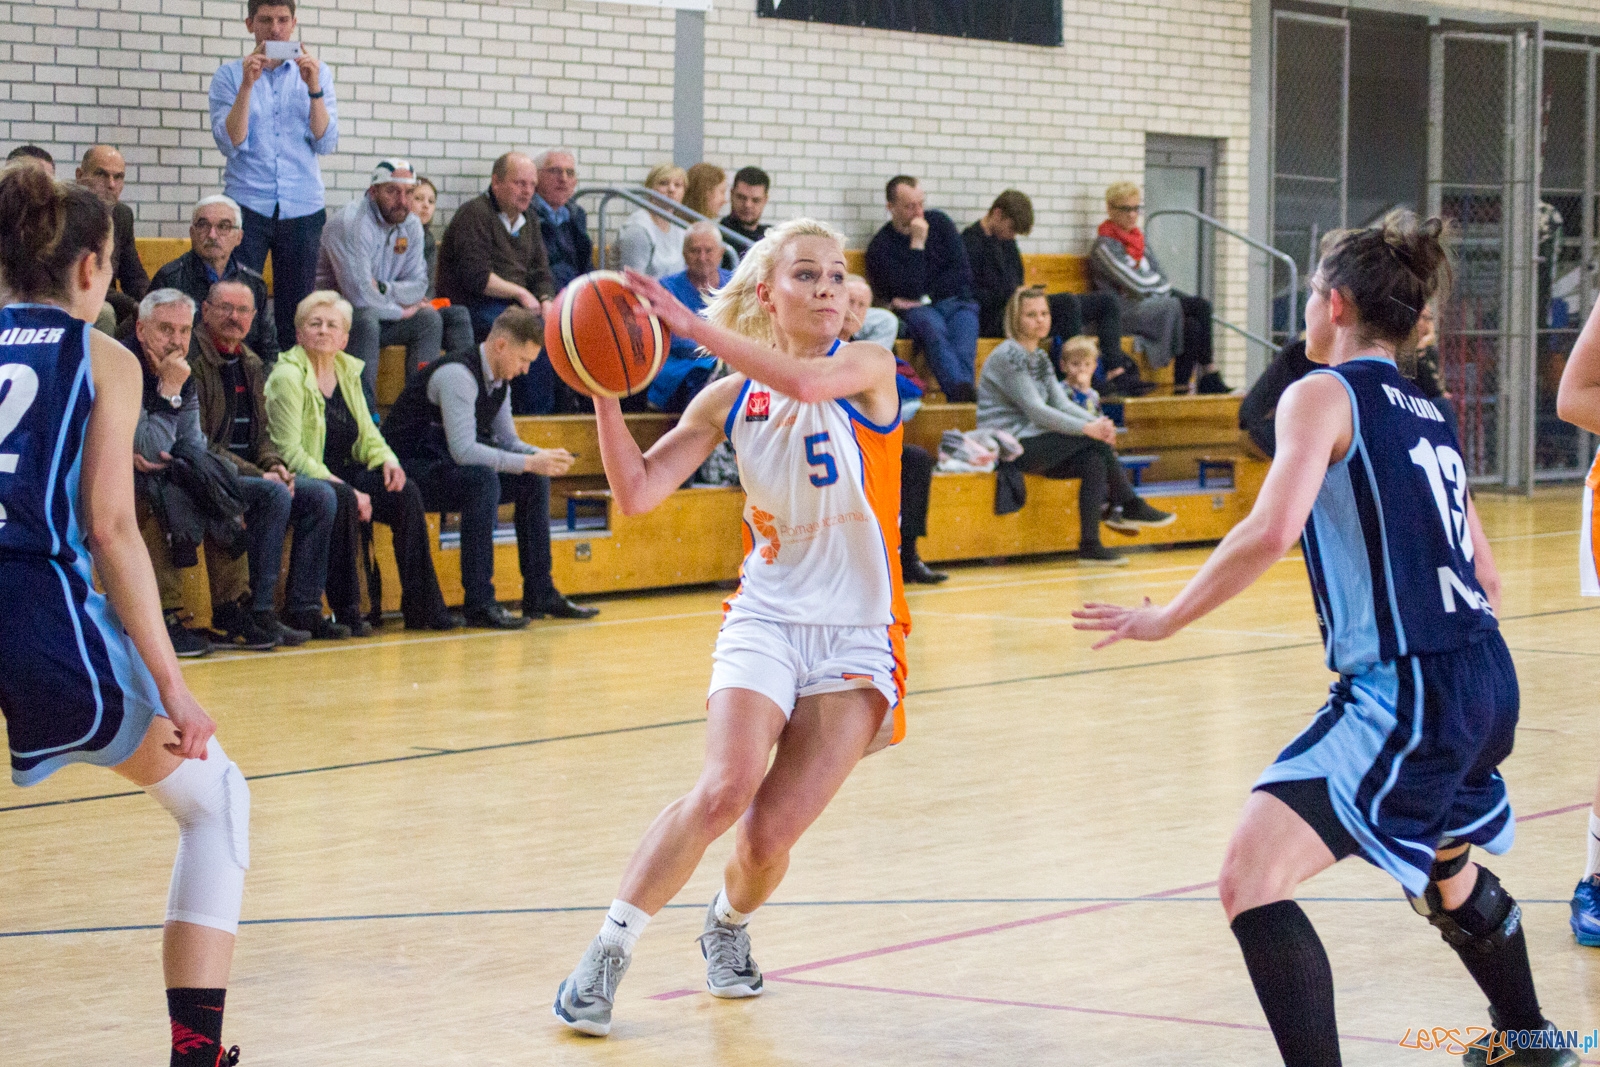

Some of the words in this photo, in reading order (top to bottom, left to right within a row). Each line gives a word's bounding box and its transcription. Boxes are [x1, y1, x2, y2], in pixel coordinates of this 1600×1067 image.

[0, 327, 65, 345] LIDER
[804, 429, 840, 489] 5
[1408, 436, 1475, 563] 13
